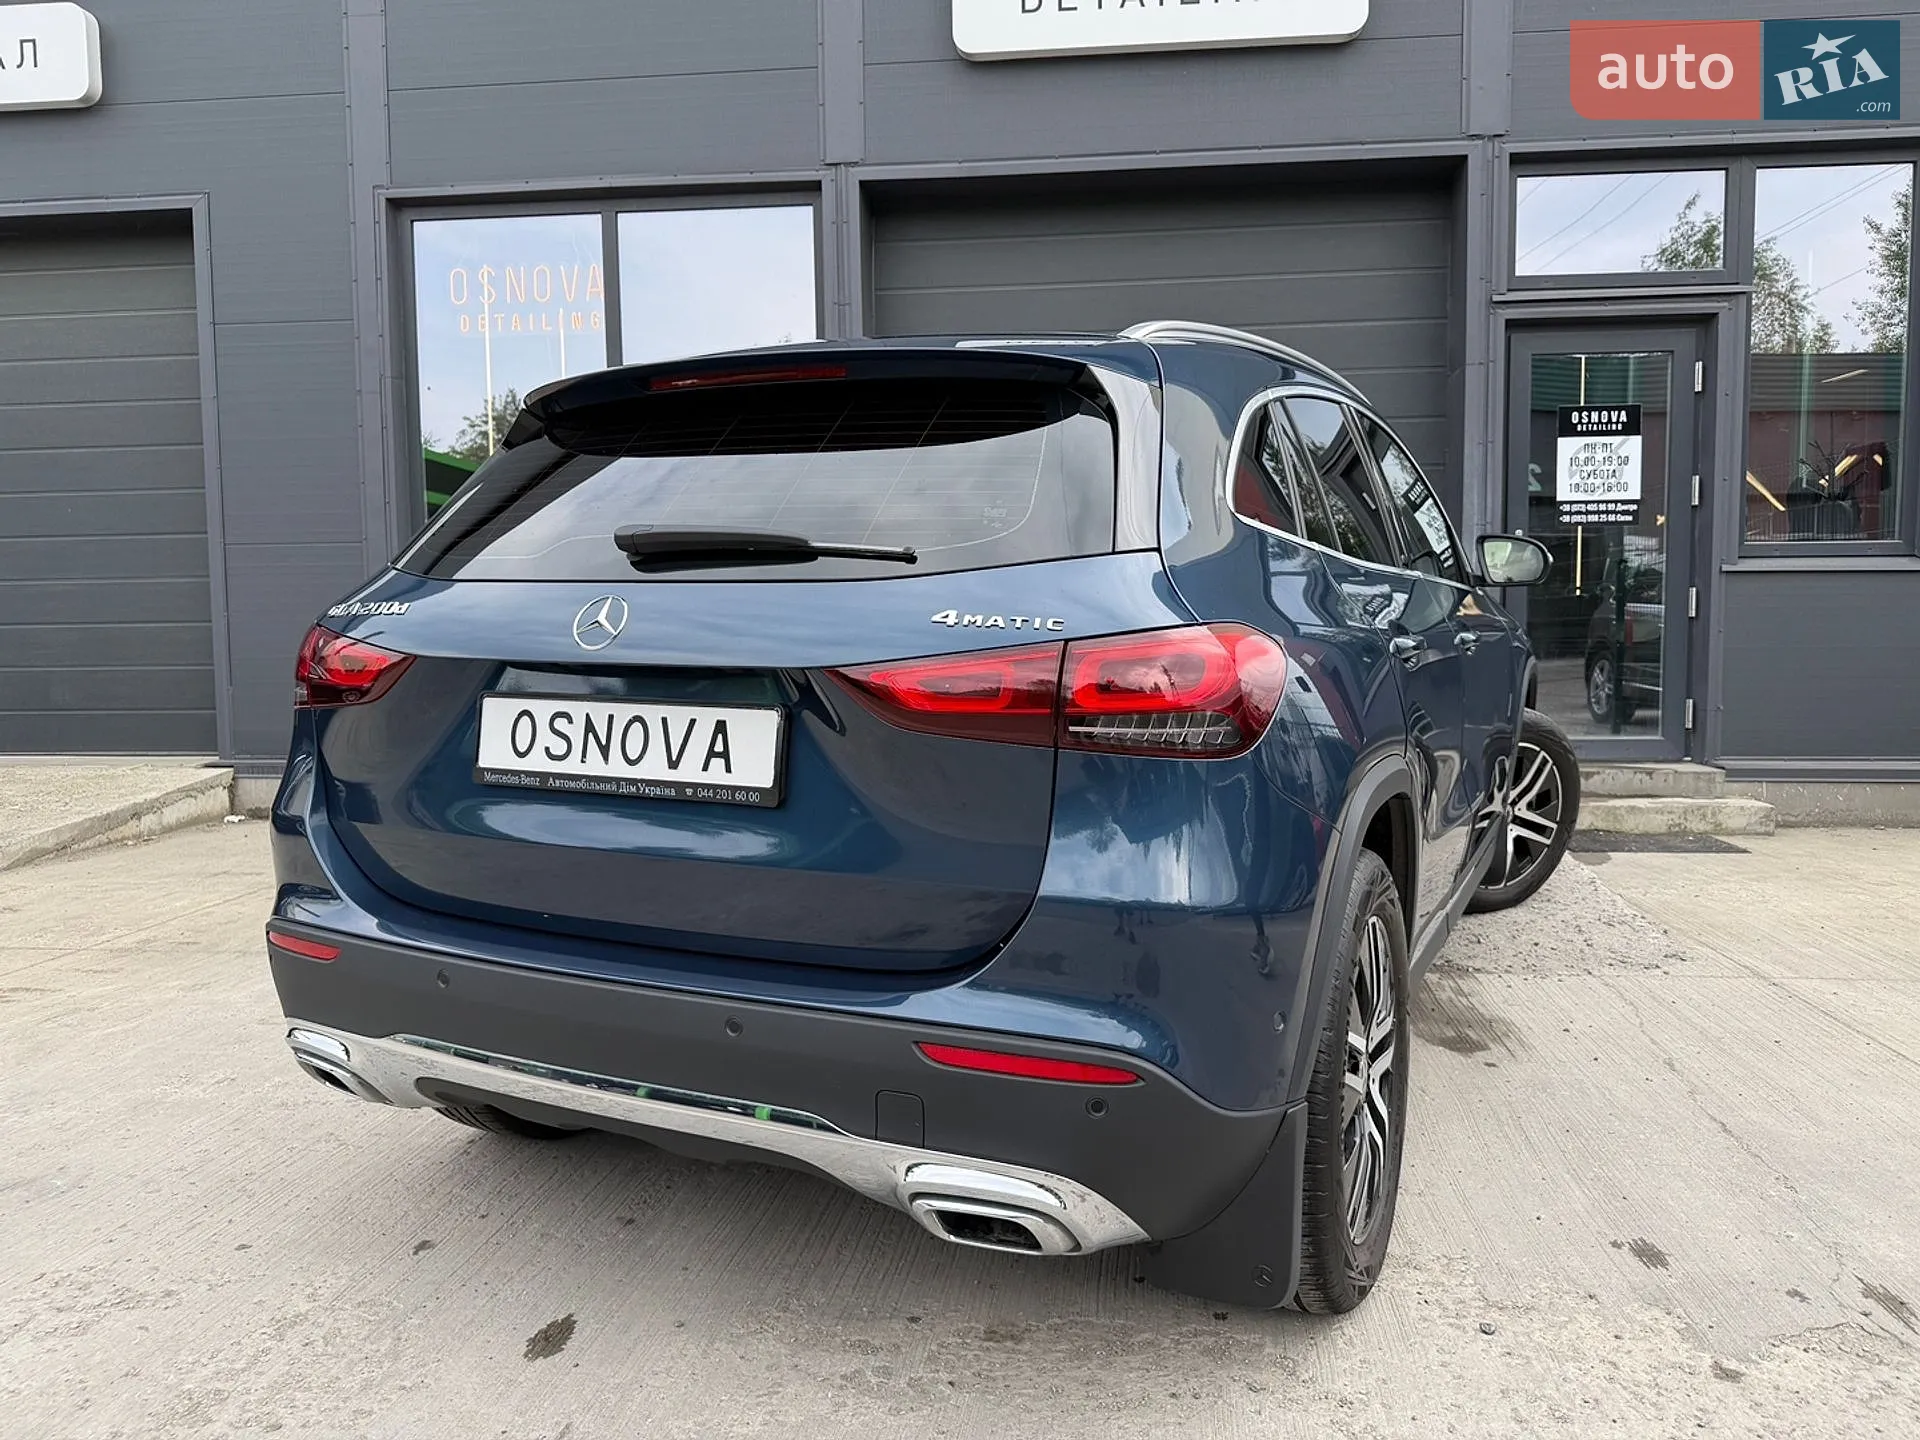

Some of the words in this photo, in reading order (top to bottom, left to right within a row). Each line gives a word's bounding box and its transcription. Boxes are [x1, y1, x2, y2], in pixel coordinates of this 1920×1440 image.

[450, 262, 604, 304] OSNOVA
[460, 310, 601, 333] DETAILING
[1571, 410, 1627, 424] OSNOVA
[1579, 469, 1618, 480] СУБОТА
[930, 609, 1065, 632] 4MATIC
[510, 709, 733, 774] OSNOVA
[484, 771, 540, 786] Mercedes-Benz
[547, 776, 617, 792] Автомобільний
[619, 781, 636, 793] Дім
[638, 783, 677, 797] Україна
[697, 787, 713, 799] 044
[716, 789, 732, 800] 201
[734, 790, 747, 801] 60
[748, 791, 761, 803] 00
